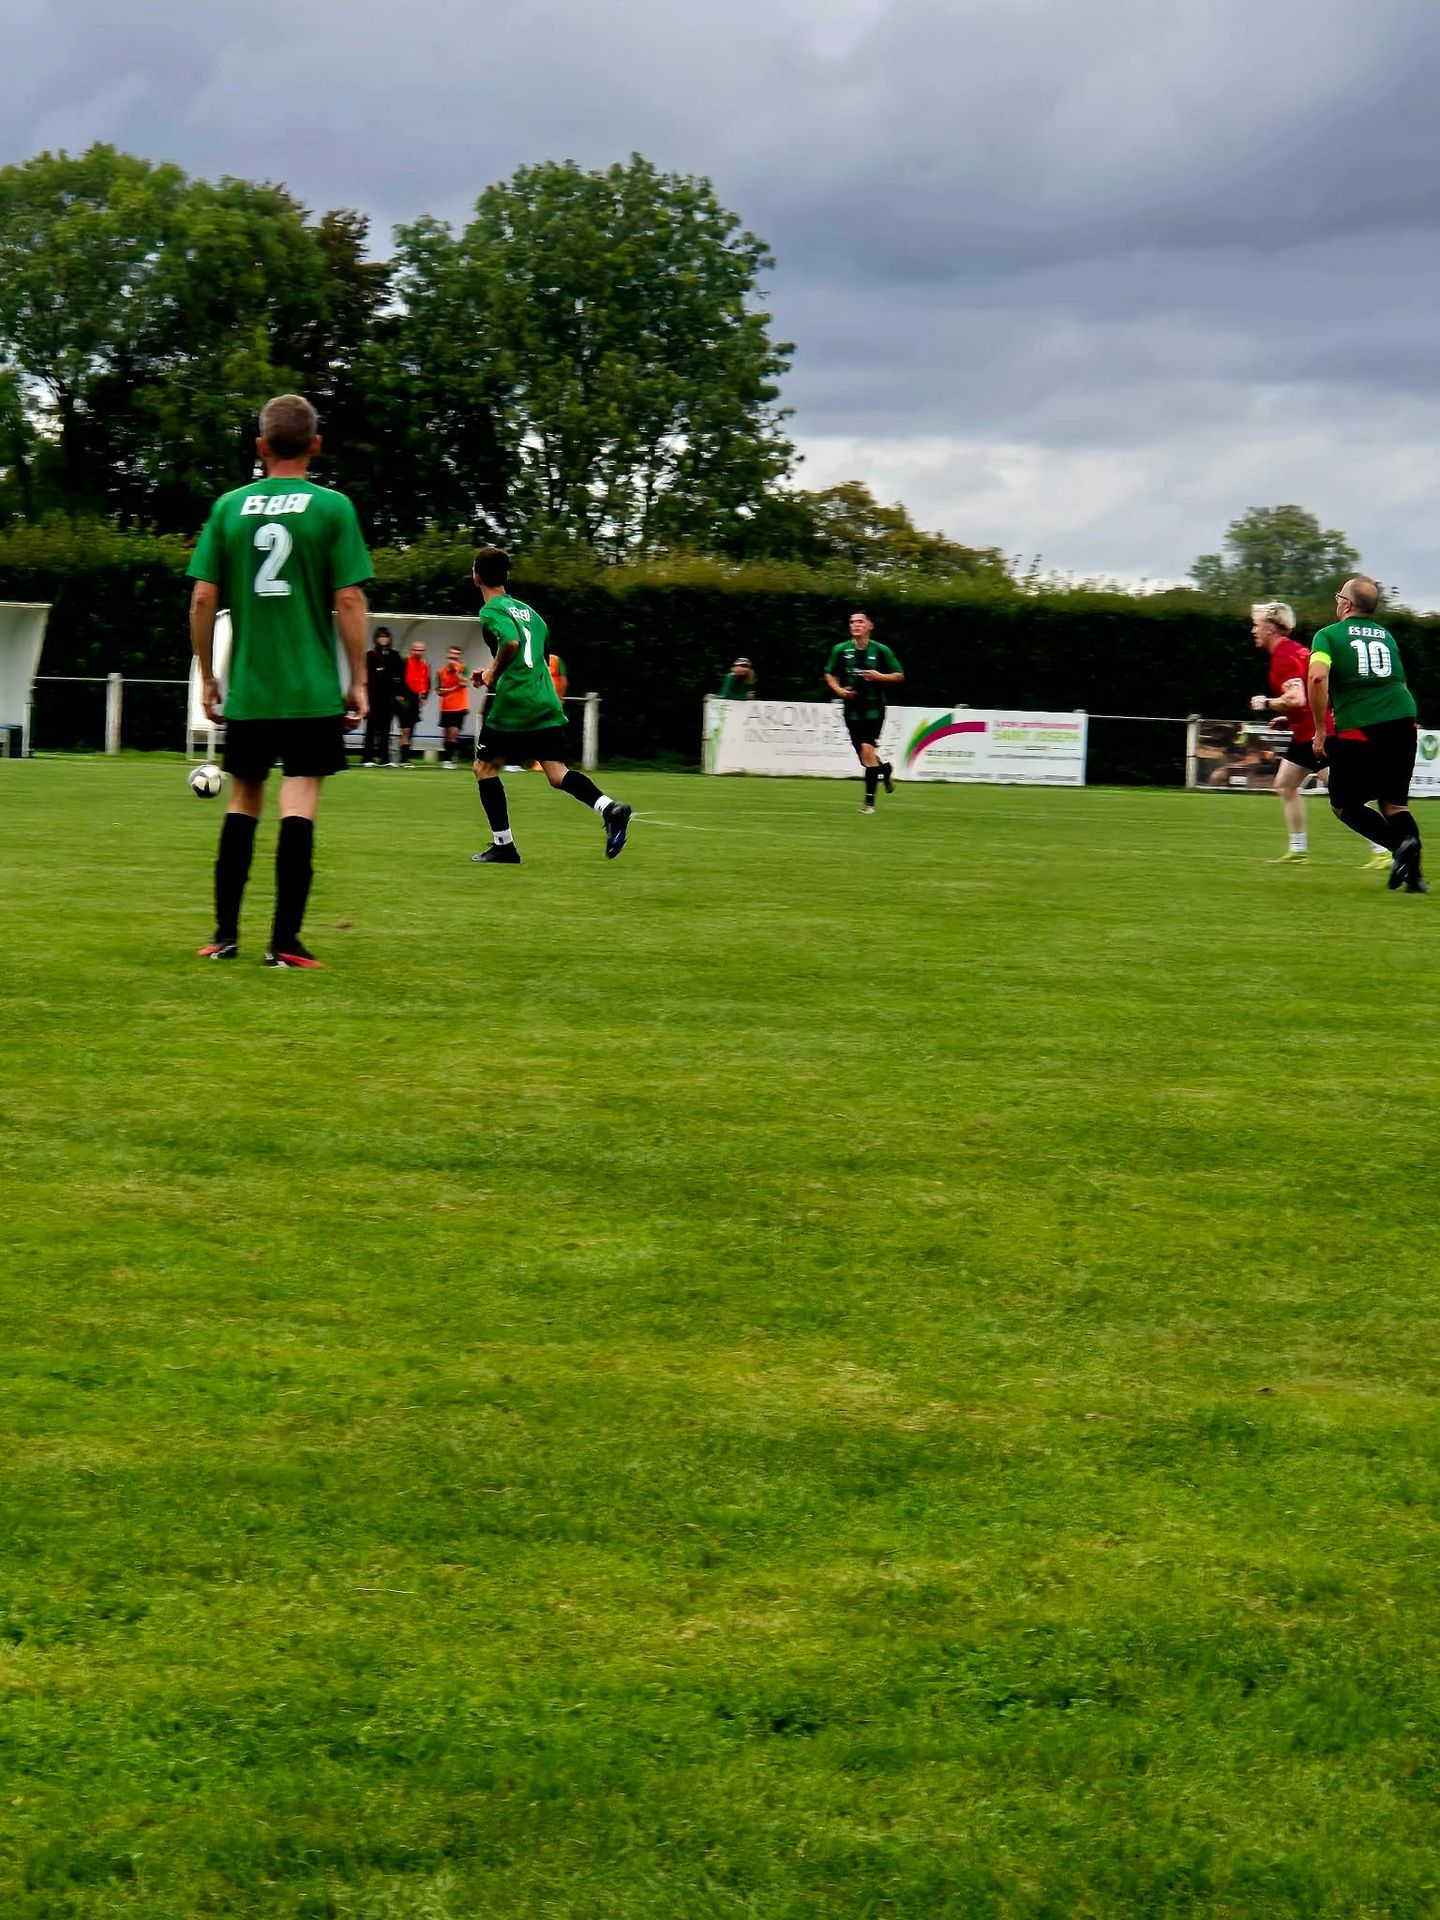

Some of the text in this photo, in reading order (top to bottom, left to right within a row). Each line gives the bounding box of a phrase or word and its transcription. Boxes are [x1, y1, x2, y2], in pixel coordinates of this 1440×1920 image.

[253, 523, 293, 597] 2
[1348, 625, 1361, 636] ES
[1350, 639, 1392, 678] 10
